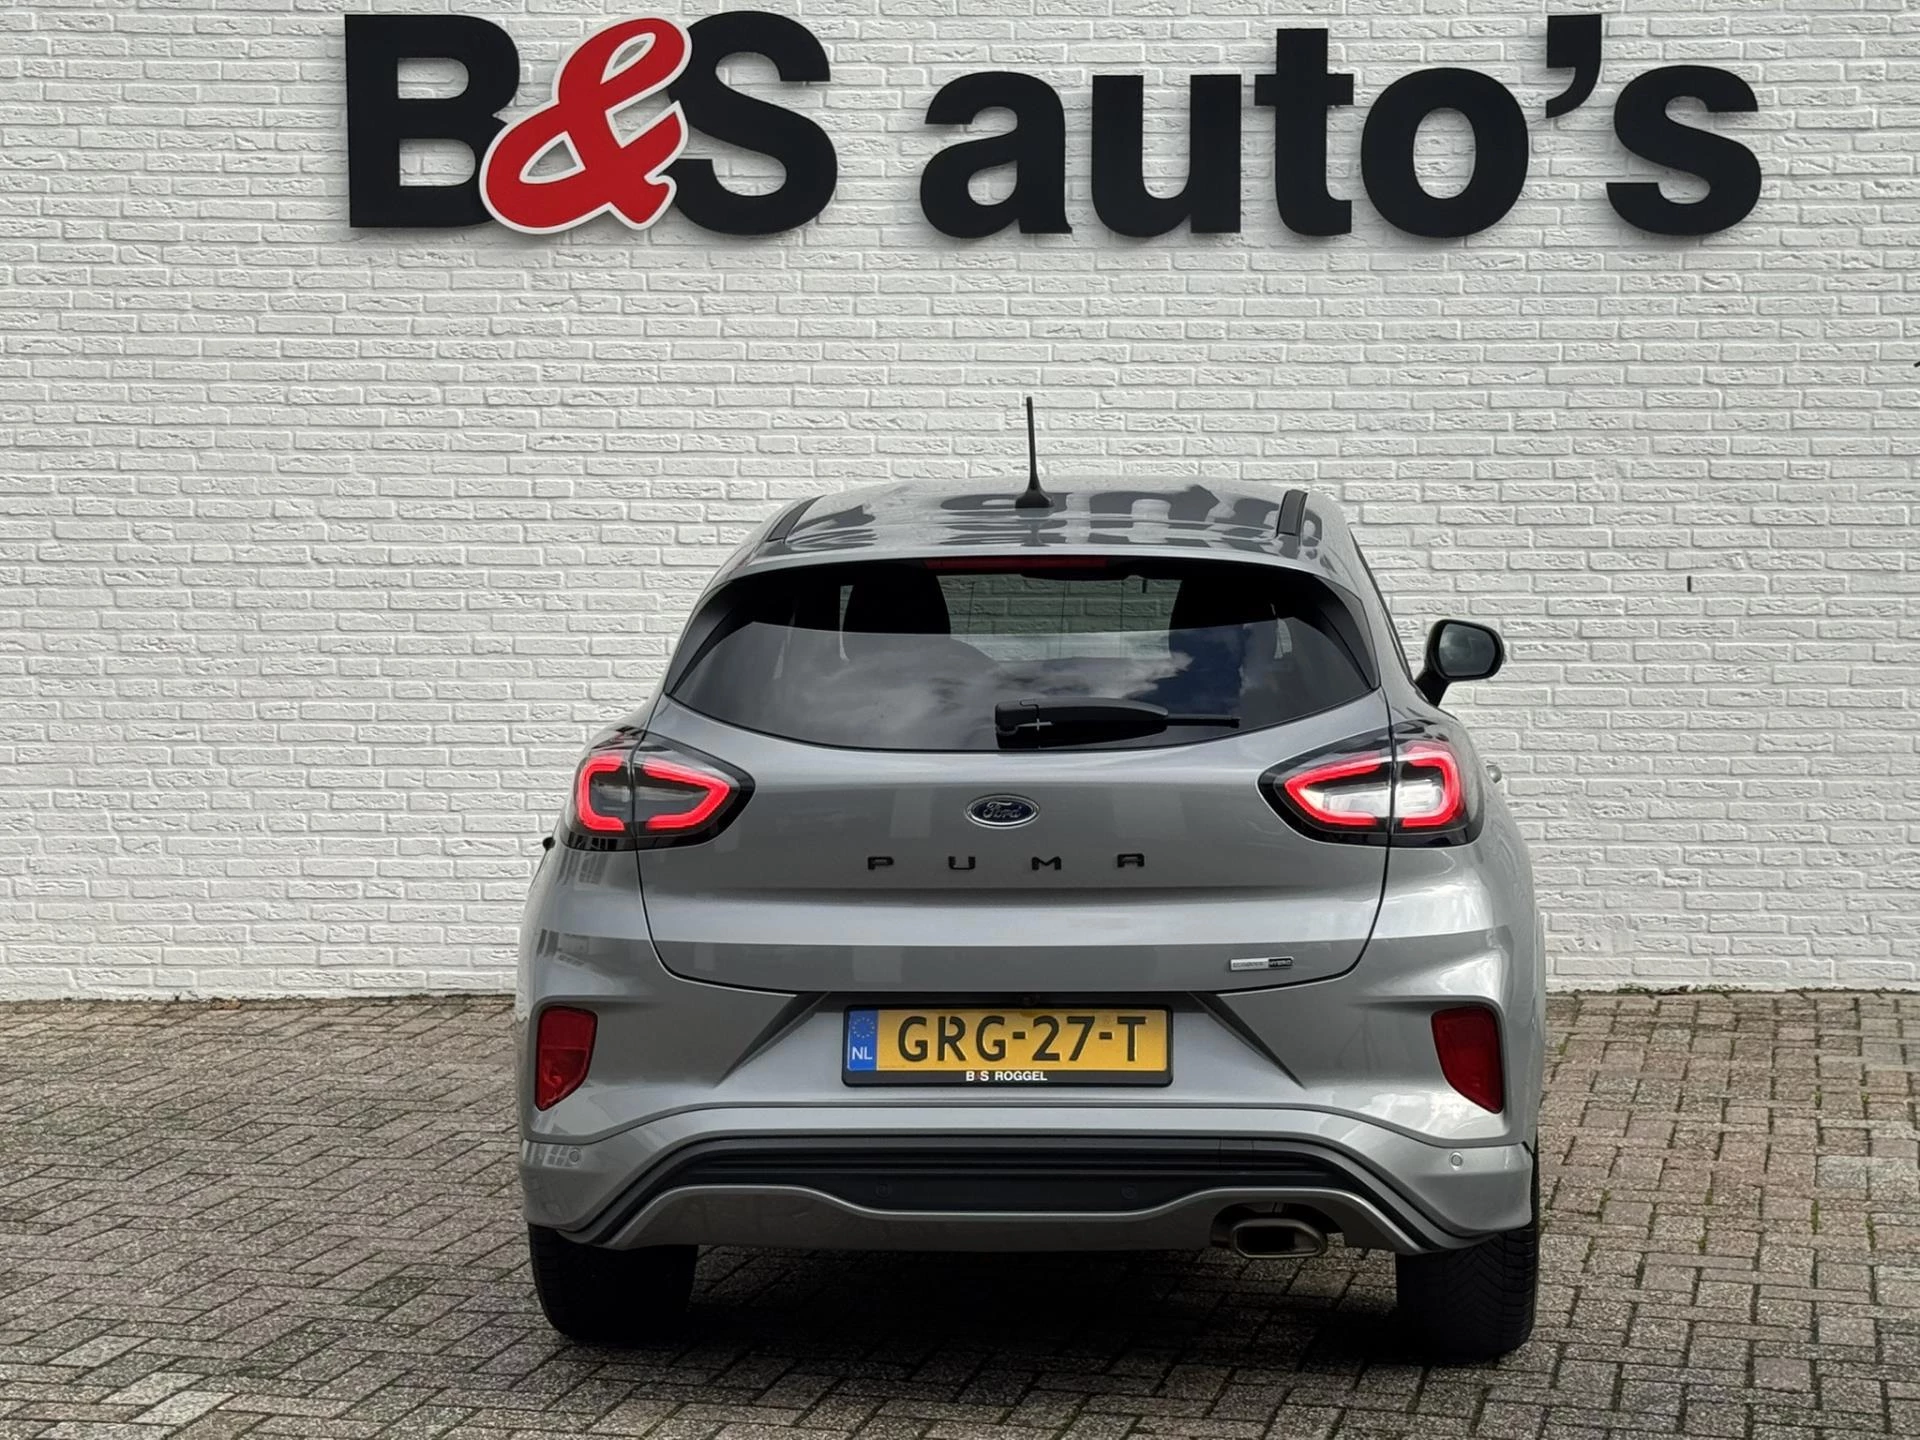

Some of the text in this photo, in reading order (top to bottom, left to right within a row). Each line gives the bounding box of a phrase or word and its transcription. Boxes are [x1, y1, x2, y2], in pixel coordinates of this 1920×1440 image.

[345, 11, 1761, 239] B&S auto's
[983, 801, 1022, 818] Ford
[867, 853, 1145, 871] PUMA
[897, 1015, 1148, 1063] GRG-27-T
[851, 1046, 873, 1060] NL
[994, 1070, 1048, 1081] ROGGEL
